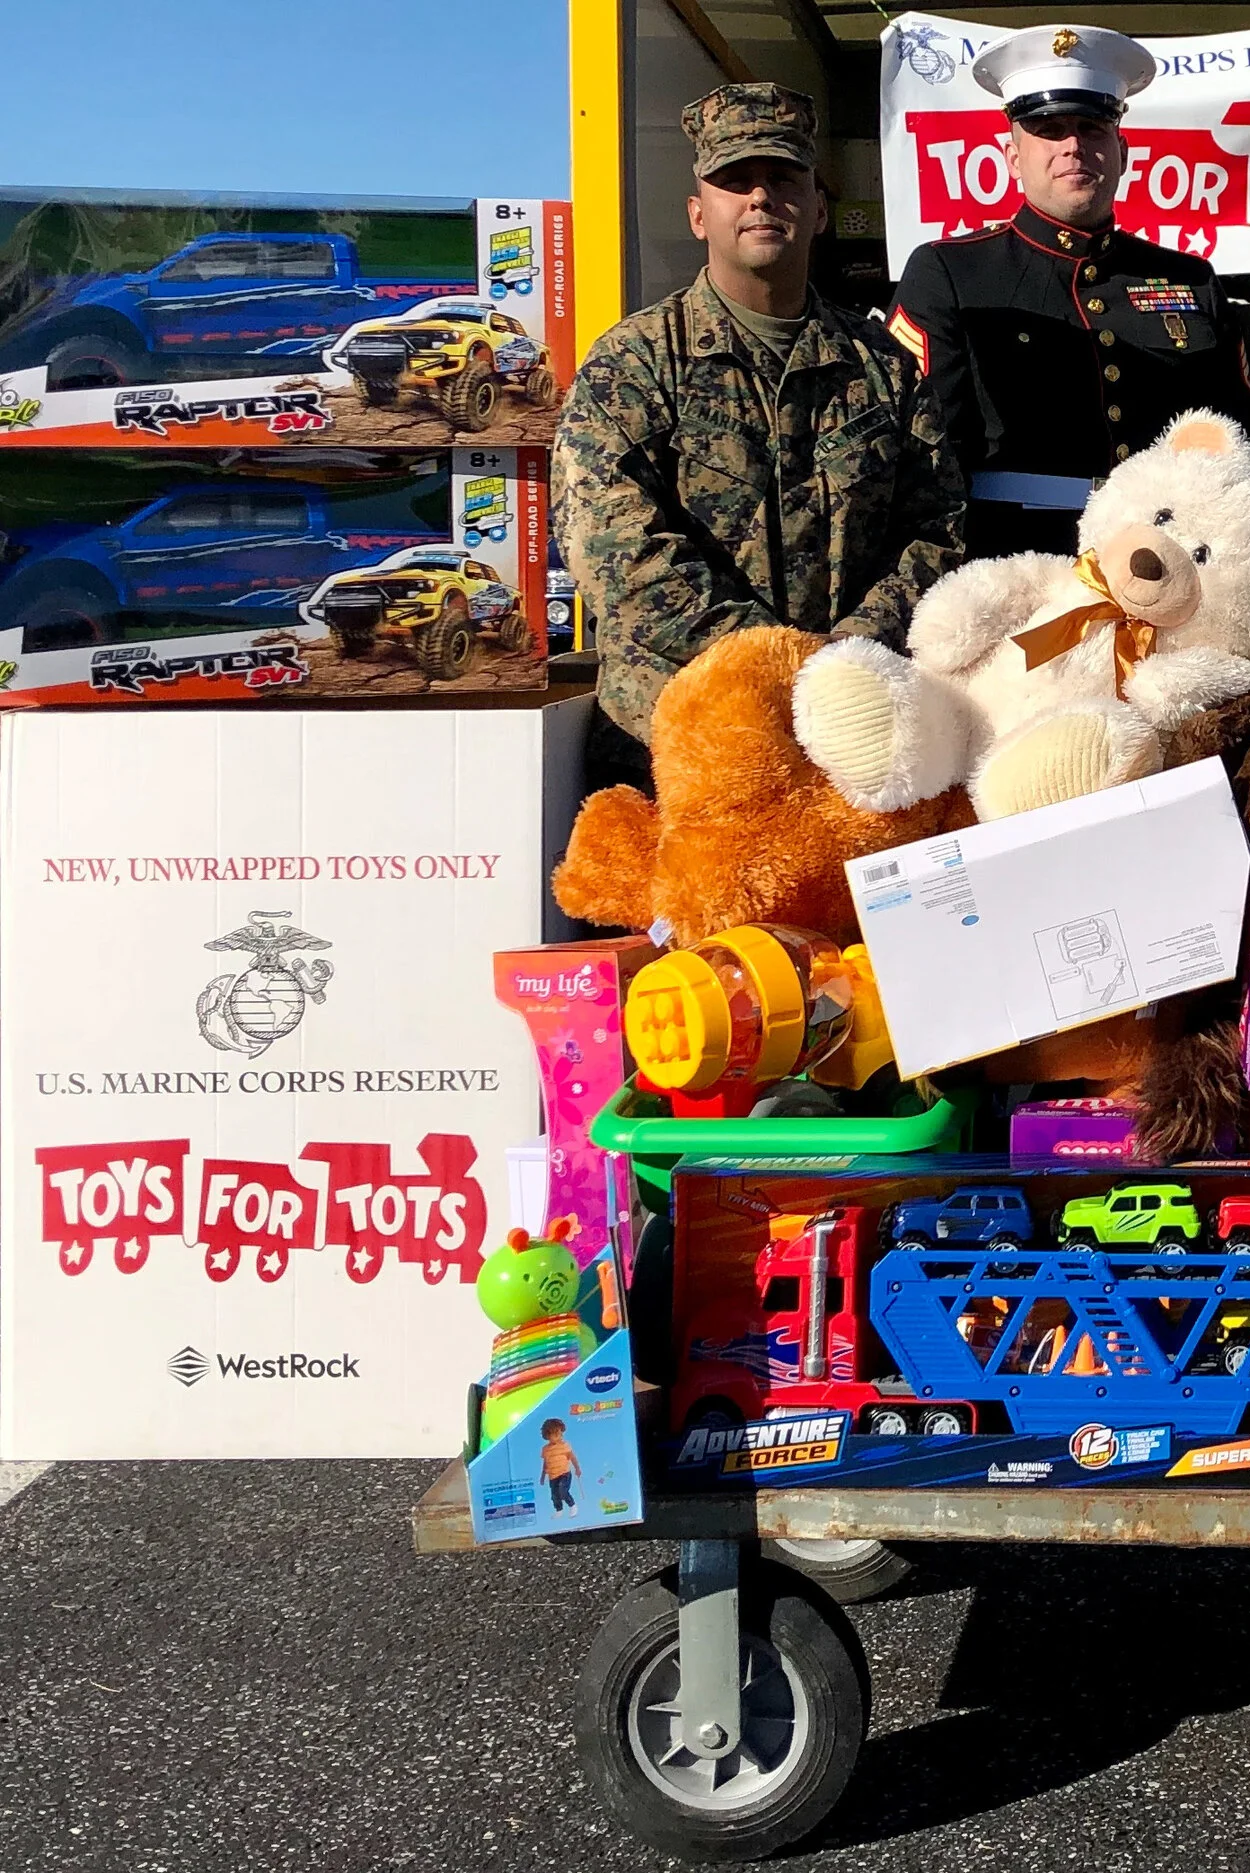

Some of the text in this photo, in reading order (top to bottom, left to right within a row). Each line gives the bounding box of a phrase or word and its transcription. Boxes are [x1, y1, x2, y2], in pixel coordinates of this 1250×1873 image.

[1154, 47, 1236, 77] ORPS
[926, 133, 1024, 204] TO
[1117, 152, 1229, 215] FOR
[495, 204, 527, 220] 8+
[115, 393, 328, 434] RAPTOR
[270, 412, 328, 431] SVT
[470, 452, 501, 467] 8+
[92, 646, 306, 692] RAPTOR
[247, 665, 303, 687] SVT
[43, 854, 501, 886] NEW, UNWRAPPED TOYS ONLY
[515, 970, 593, 998] my life
[36, 1069, 500, 1096] U.S. MARINE CORPS RESERVE
[50, 1158, 172, 1228] TOYS
[204, 1174, 302, 1239] FOR
[334, 1183, 467, 1251] TOTS
[217, 1352, 360, 1380] WestRock
[586, 1372, 620, 1385] vtech
[676, 1416, 845, 1464] ADVENTURE
[1079, 1428, 1113, 1457] 12
[735, 1444, 827, 1469] FORCE
[1007, 1462, 1054, 1473] WARNING:
